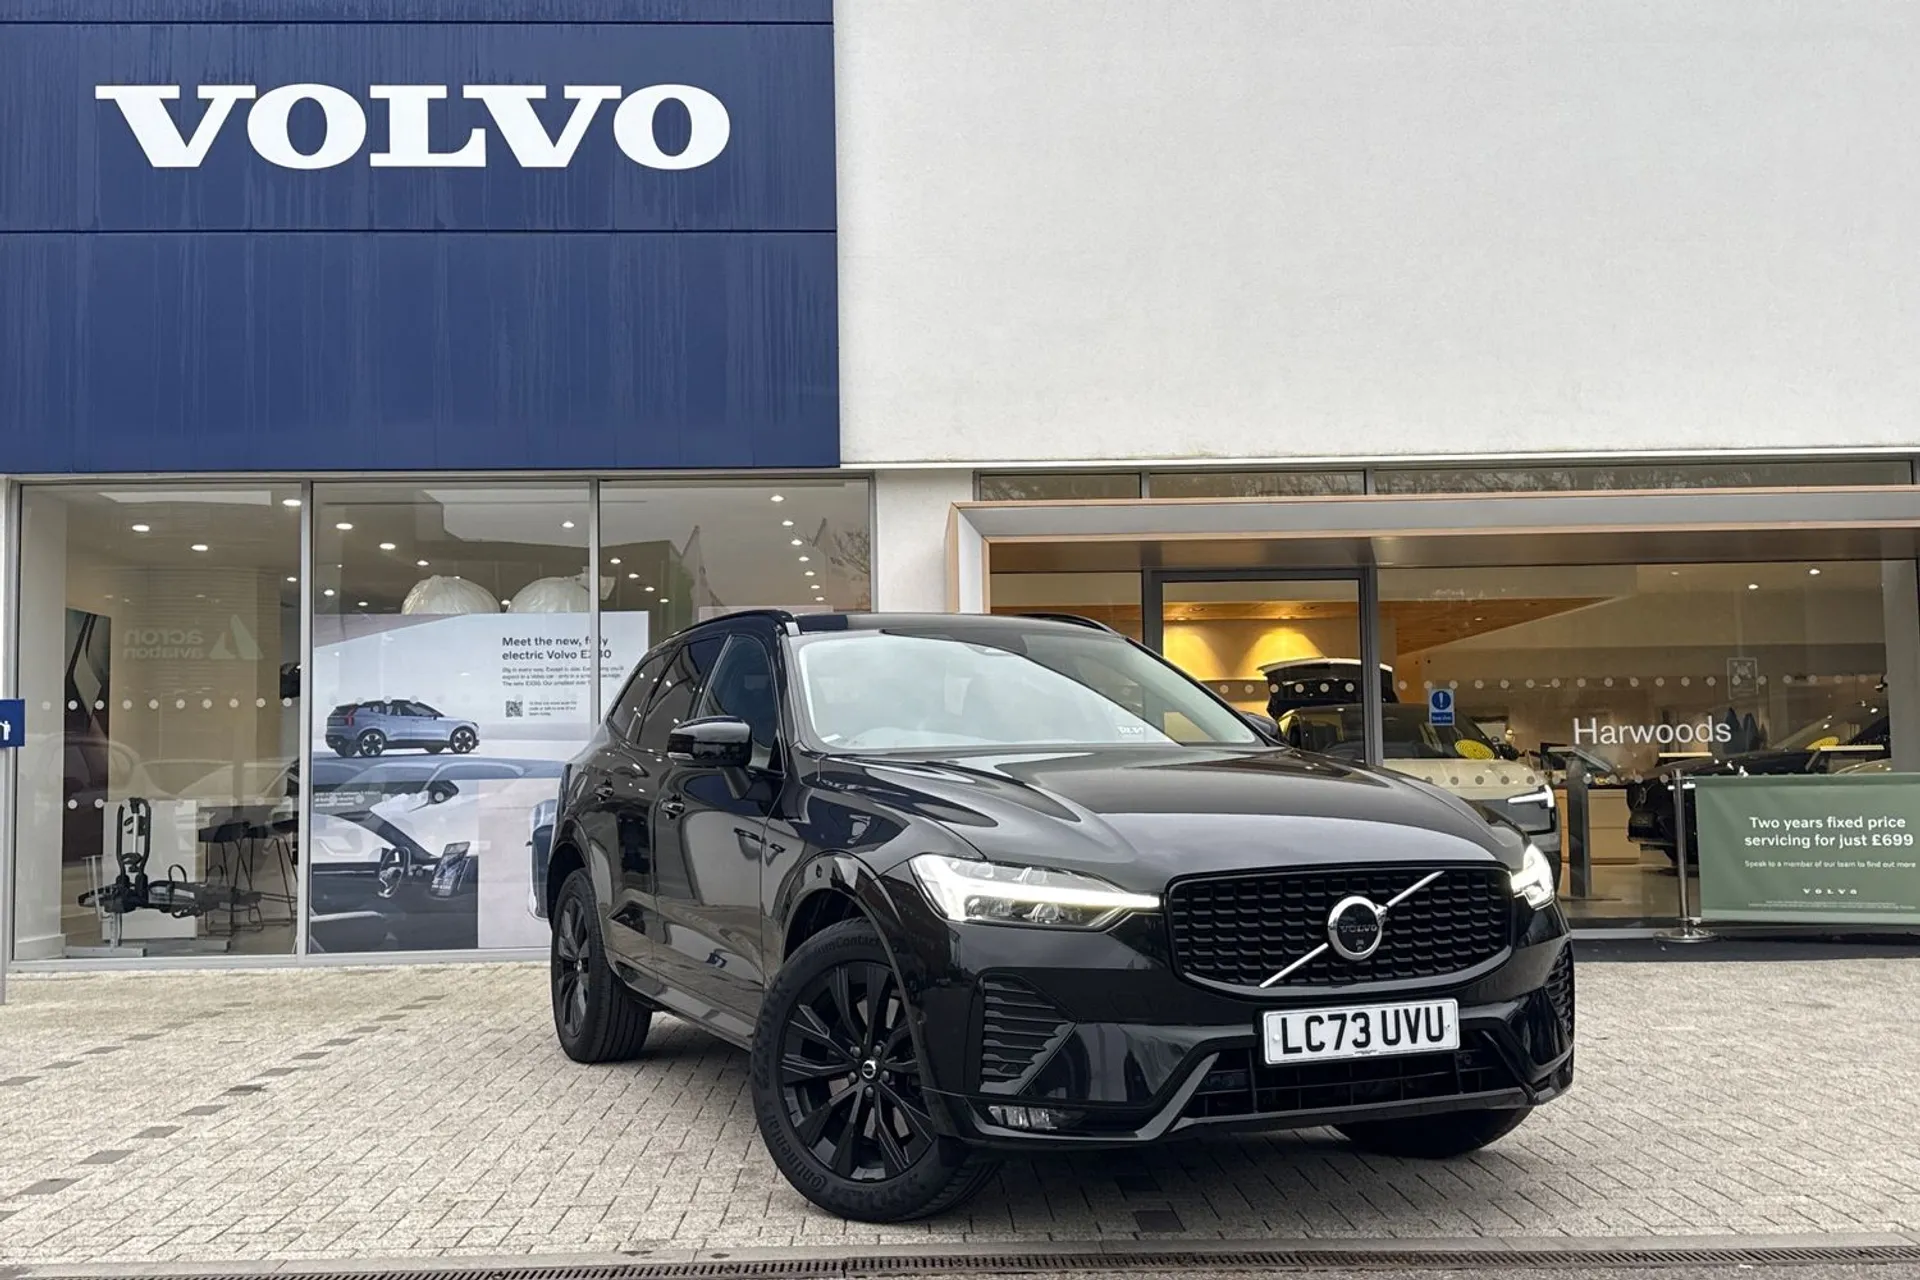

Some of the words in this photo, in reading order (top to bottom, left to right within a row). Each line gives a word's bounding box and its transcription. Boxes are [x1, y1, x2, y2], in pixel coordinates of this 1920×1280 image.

[95, 83, 731, 170] VOLVO
[502, 637, 531, 646] Meet
[535, 636, 553, 646] the
[556, 638, 582, 647] new,
[502, 650, 544, 660] electric
[547, 650, 577, 660] Volvo
[1573, 715, 1732, 745] Harwoods
[1749, 816, 1780, 828] Two
[1783, 819, 1823, 831] years
[1827, 816, 1864, 828] fixed
[1868, 816, 1906, 831] price
[1744, 834, 1811, 849] servicing
[1815, 834, 1836, 846] for
[1839, 834, 1868, 849] just
[1872, 833, 1914, 846] £699
[1745, 860, 1767, 868] Speak
[1867, 860, 1881, 868] find
[1338, 925, 1378, 933] VOLVO
[1281, 1011, 1372, 1055] LC73
[1381, 1006, 1445, 1046] UVU
